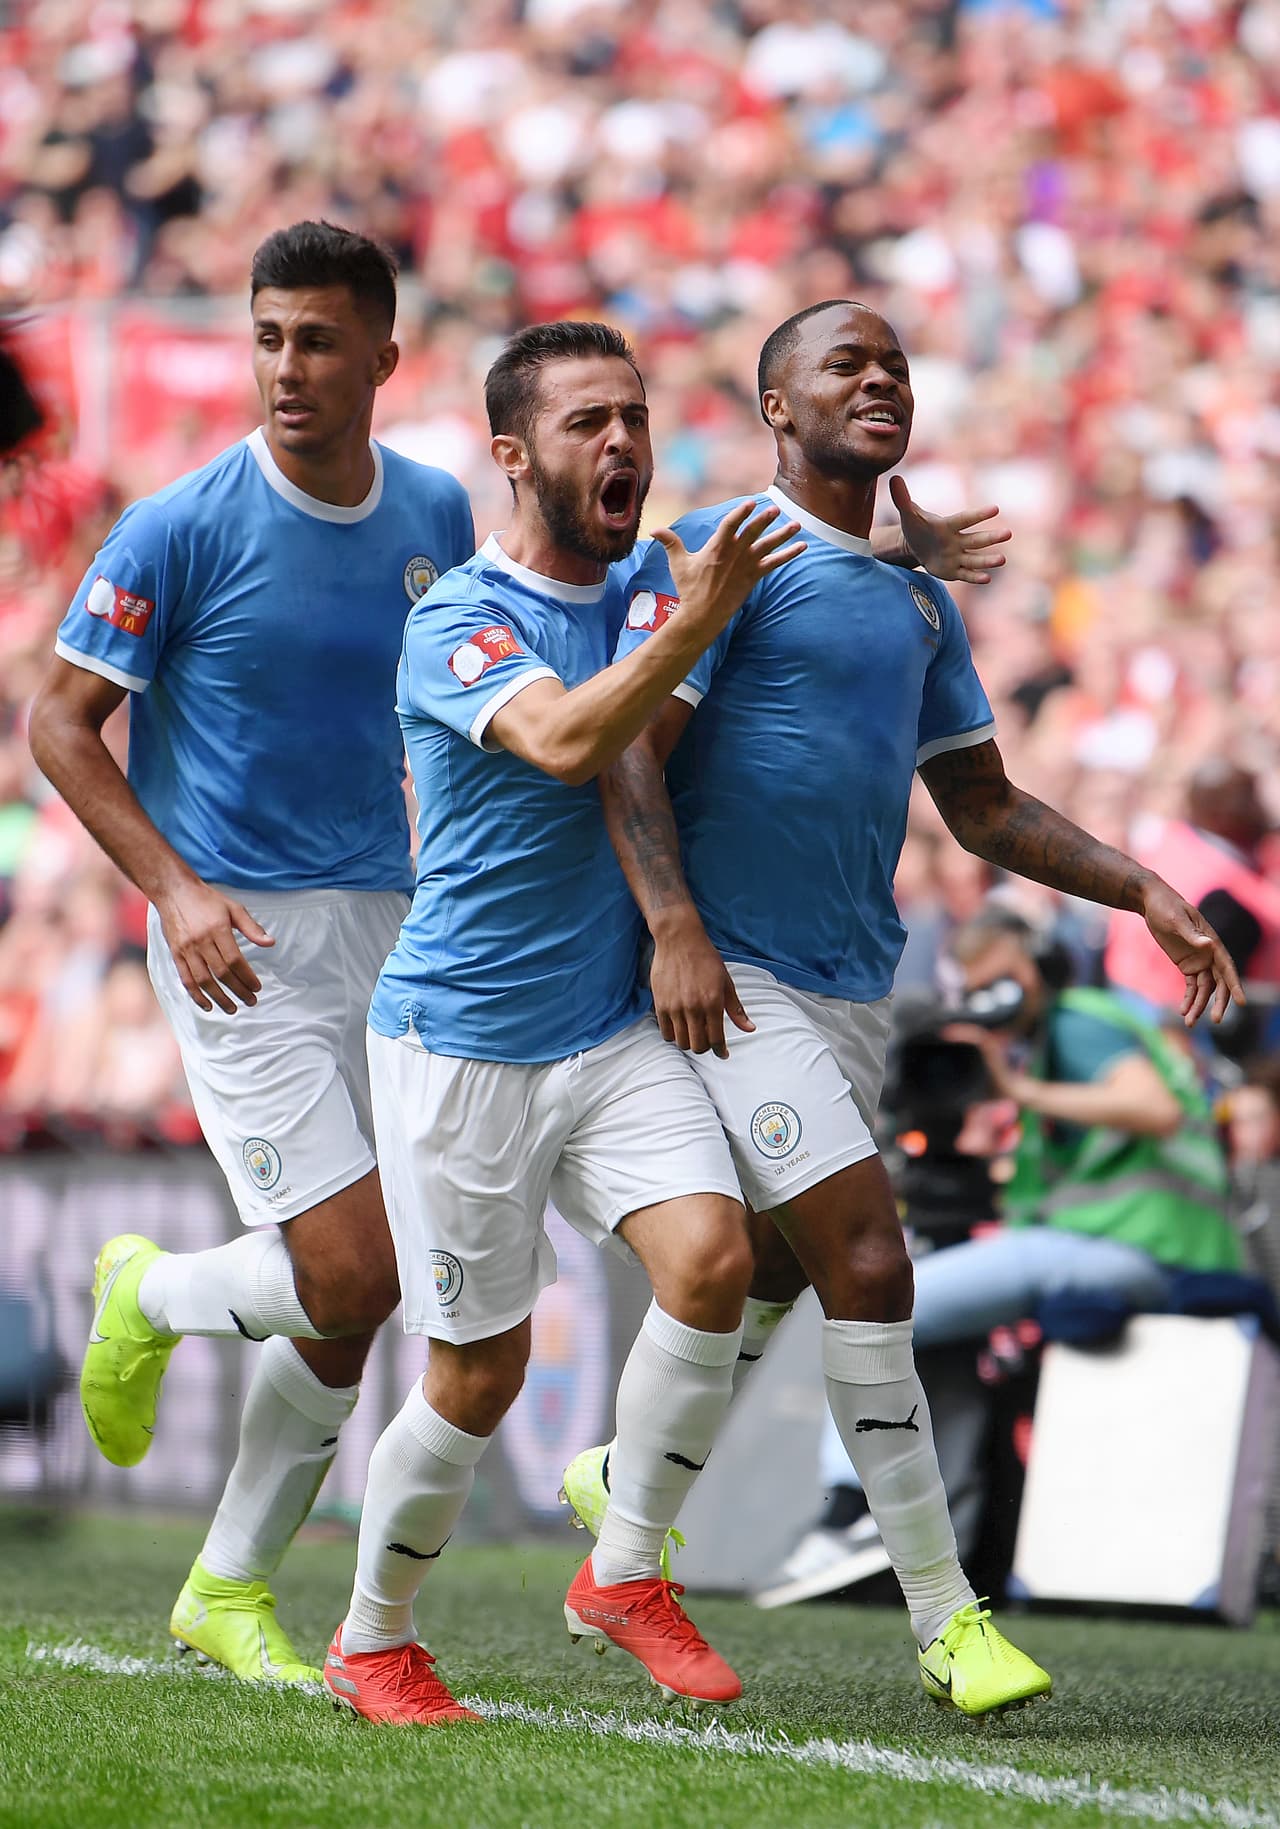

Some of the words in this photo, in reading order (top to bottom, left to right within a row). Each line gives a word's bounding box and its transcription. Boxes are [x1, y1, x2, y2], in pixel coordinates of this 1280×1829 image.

[754, 1105, 790, 1134] MANCHESTER
[776, 1143, 791, 1156] CITY
[773, 1164, 786, 1177] 125
[785, 1150, 811, 1169] YEARS
